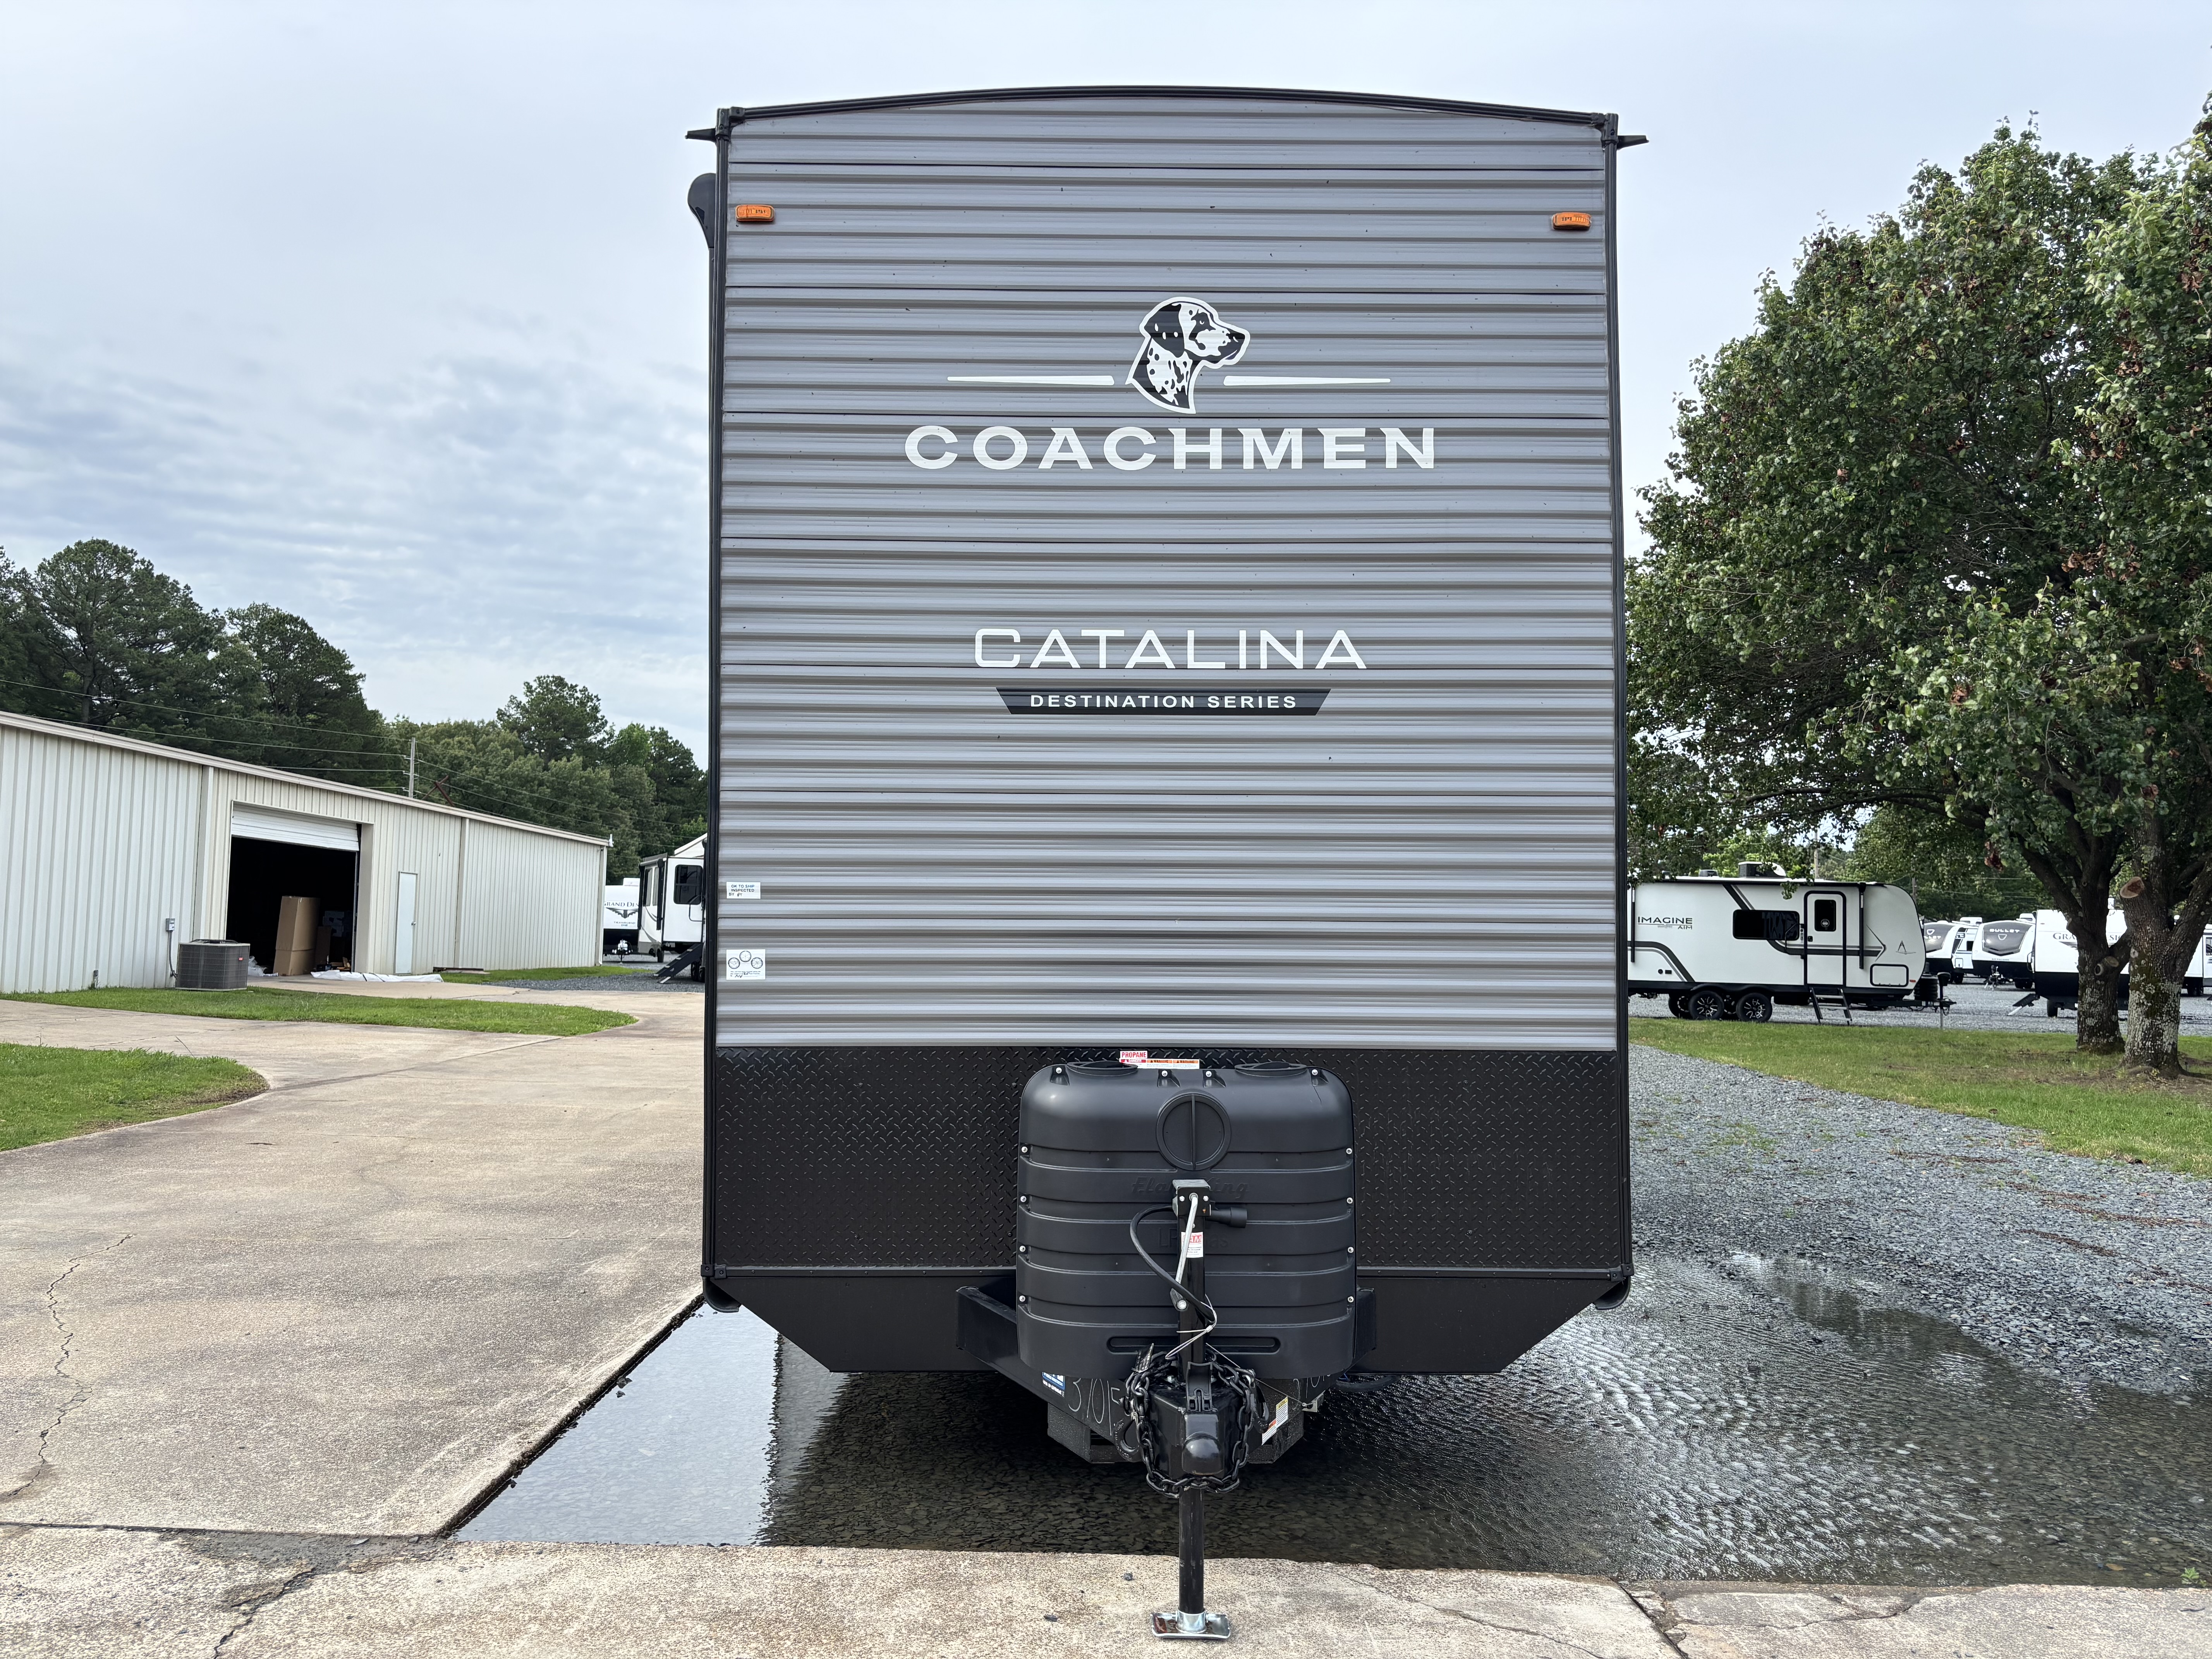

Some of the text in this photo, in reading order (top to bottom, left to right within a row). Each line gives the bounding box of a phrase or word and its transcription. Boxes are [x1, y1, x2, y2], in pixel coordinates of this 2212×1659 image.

[905, 426, 1434, 470] COACHMEN
[975, 629, 1367, 669] CATALINA
[1030, 695, 1296, 708] DESTINATION SERIES
[1132, 1176, 1172, 1193] Fla
